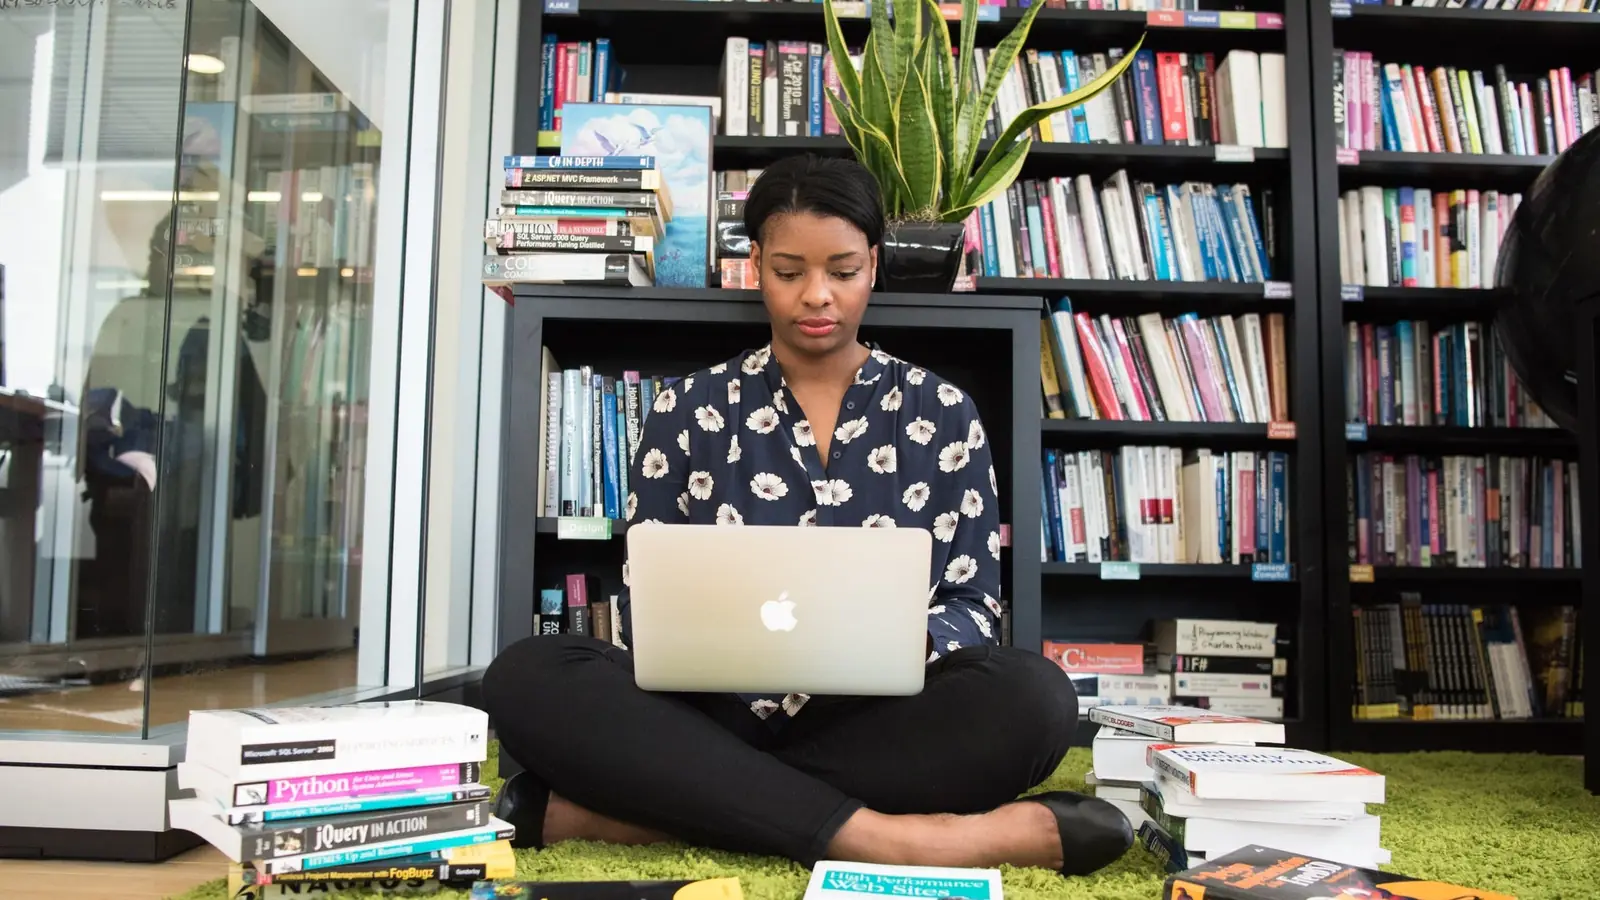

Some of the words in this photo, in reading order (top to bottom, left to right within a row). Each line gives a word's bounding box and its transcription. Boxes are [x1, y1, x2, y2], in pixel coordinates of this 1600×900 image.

[792, 74, 802, 98] 2010
[783, 87, 792, 119] Platform
[548, 156, 561, 168] C#
[562, 156, 573, 167] IN
[574, 157, 604, 167] DEPTH
[532, 174, 560, 182] ASP.NET
[562, 174, 578, 182] MVC
[578, 175, 618, 184] Framework
[544, 191, 575, 206] jQuery
[586, 196, 614, 204] ACTION
[504, 222, 558, 234] PYTHON
[558, 241, 578, 250] Tuning
[580, 242, 605, 250] Distilled
[570, 234, 589, 243] Query
[629, 386, 638, 409] Holub
[1192, 657, 1208, 672] F#
[292, 747, 316, 756] Server
[275, 776, 350, 800] Python
[314, 824, 369, 850] jQuery
[371, 822, 384, 837] IN
[386, 816, 428, 835] ACTION
[345, 852, 358, 862] Up
[360, 850, 376, 858] and
[390, 867, 434, 880] FogBugz
[830, 871, 870, 882] High
[876, 876, 984, 888] Performance
[828, 879, 884, 893] Web
[892, 884, 950, 897] Sites
